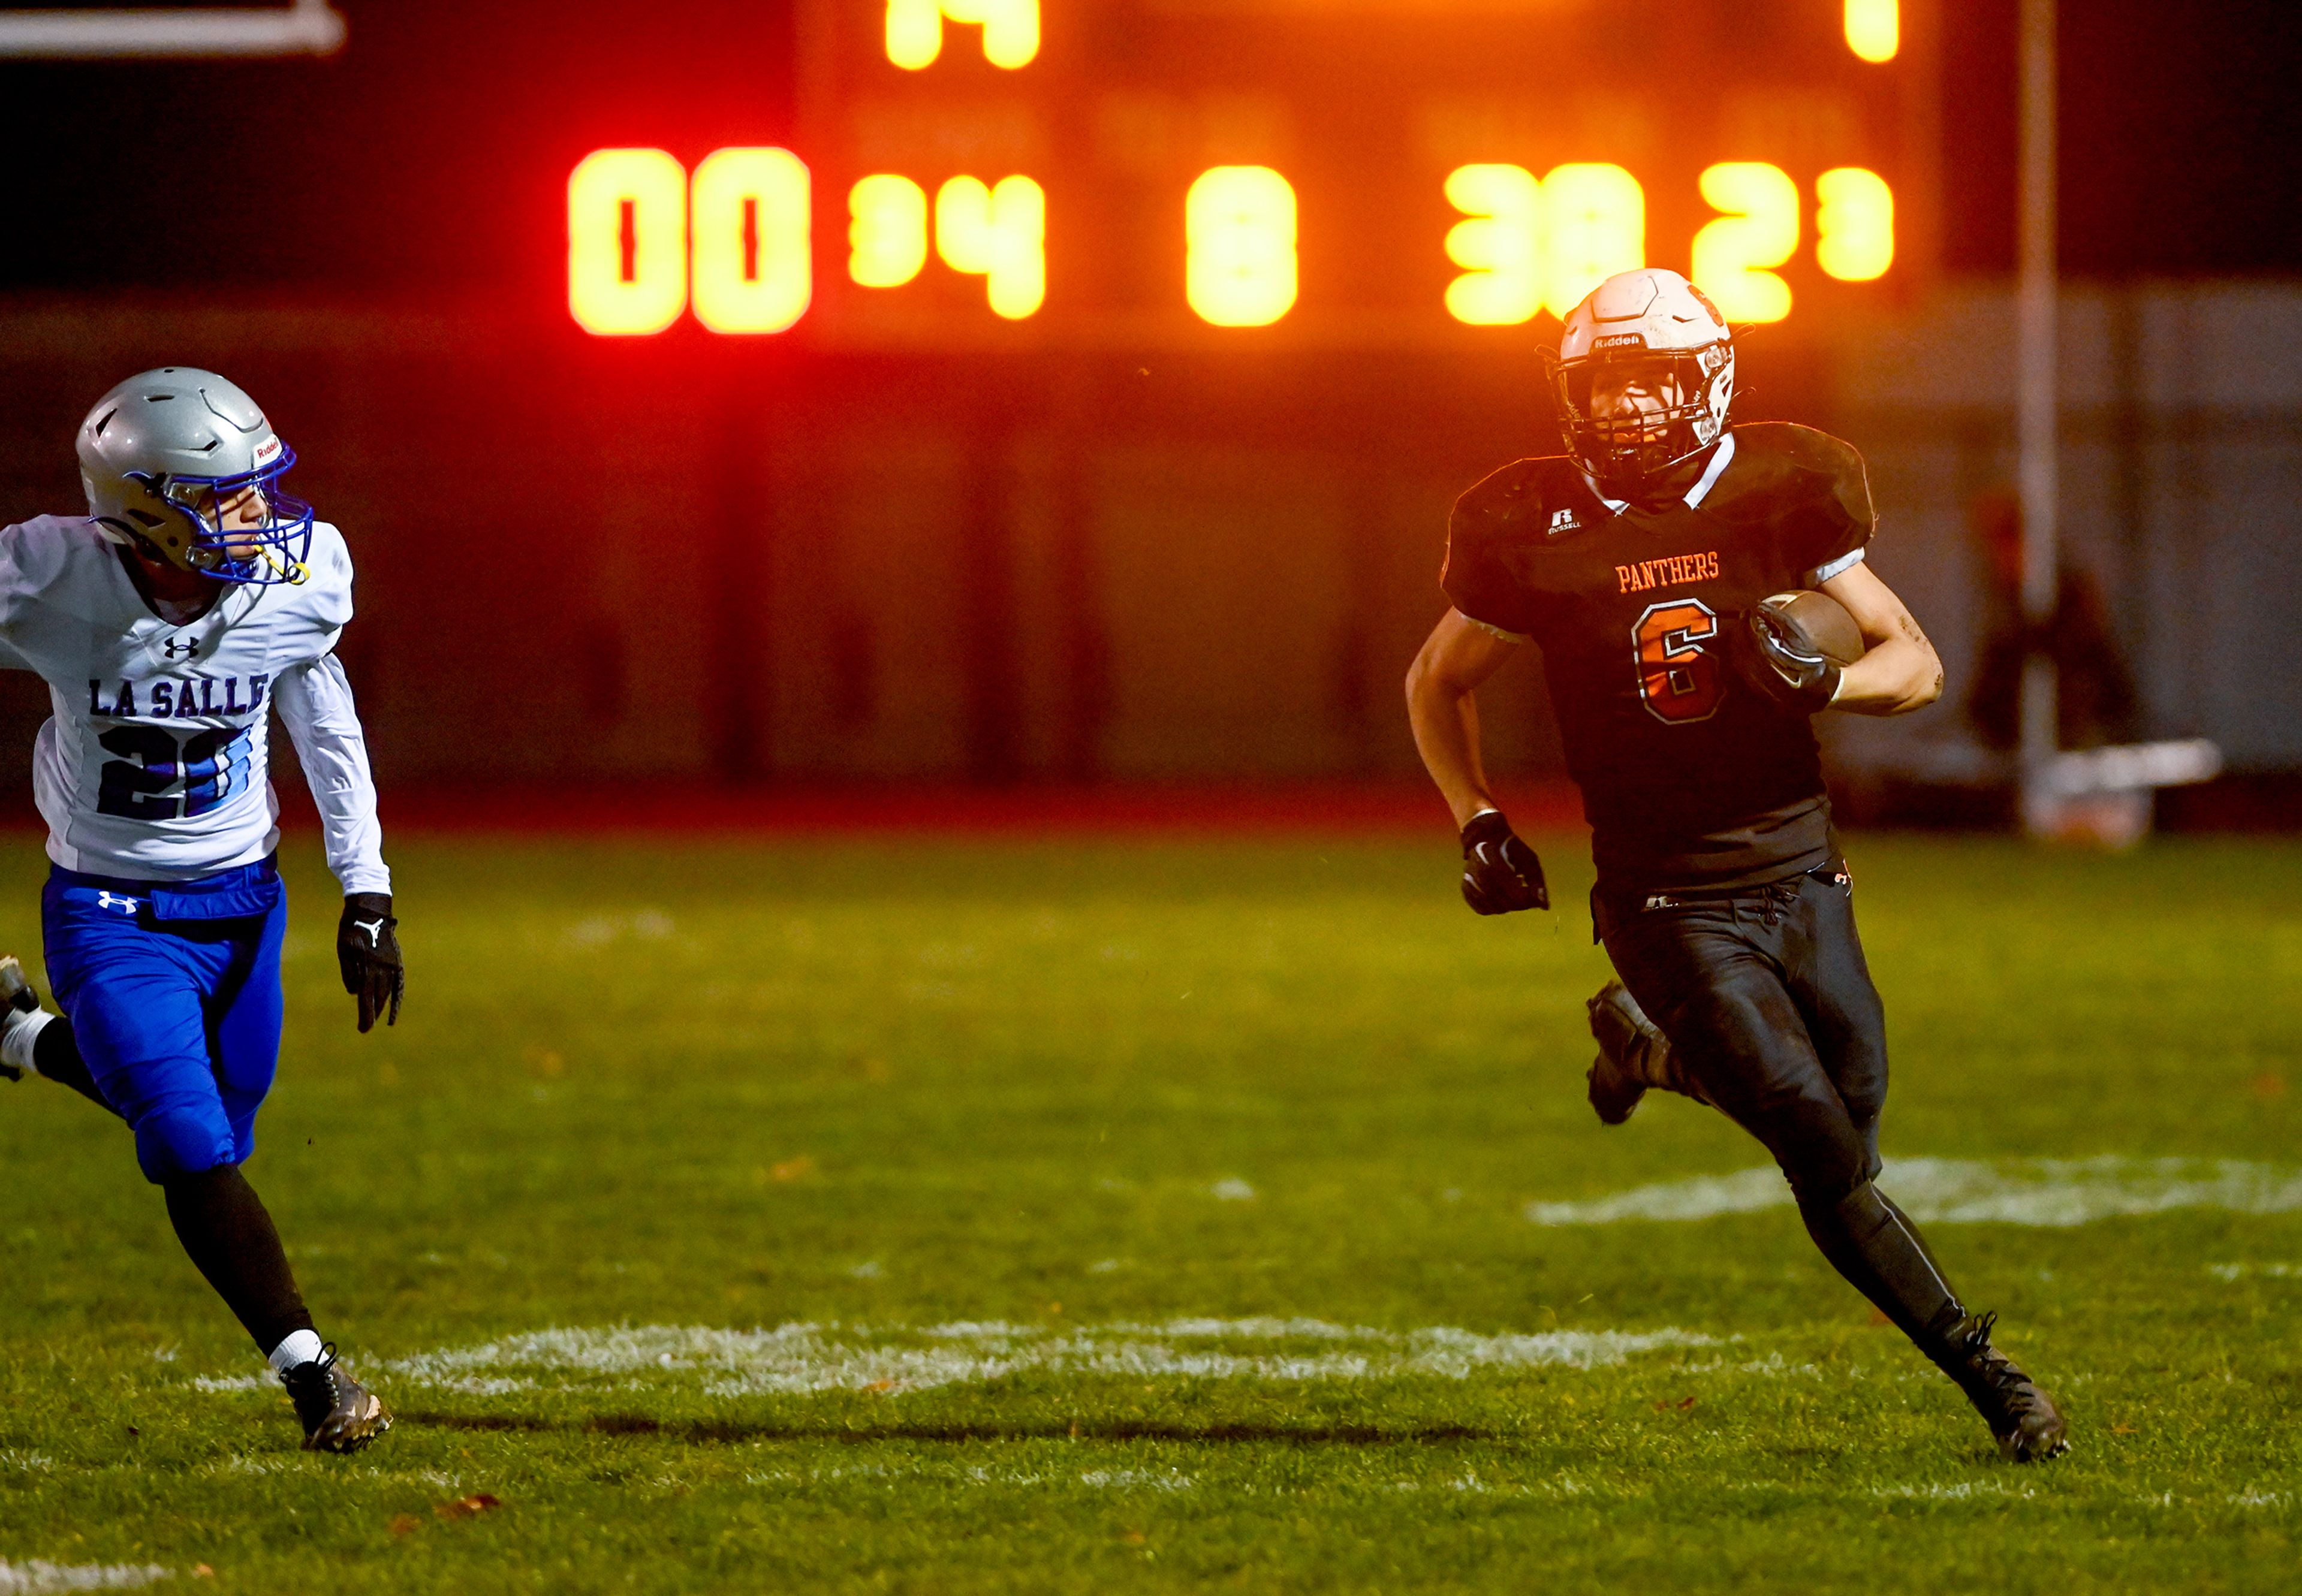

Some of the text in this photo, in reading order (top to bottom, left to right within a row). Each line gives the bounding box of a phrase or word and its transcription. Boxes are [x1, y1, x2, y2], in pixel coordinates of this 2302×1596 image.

[568, 147, 811, 335] 00
[1185, 164, 1298, 328] 8
[1595, 335, 1640, 348] Riddell
[1548, 521, 1582, 535] RUSSELL
[1615, 551, 1719, 594] PANTHERS
[1631, 598, 1728, 725] 6
[89, 673, 269, 719] LA SALLE
